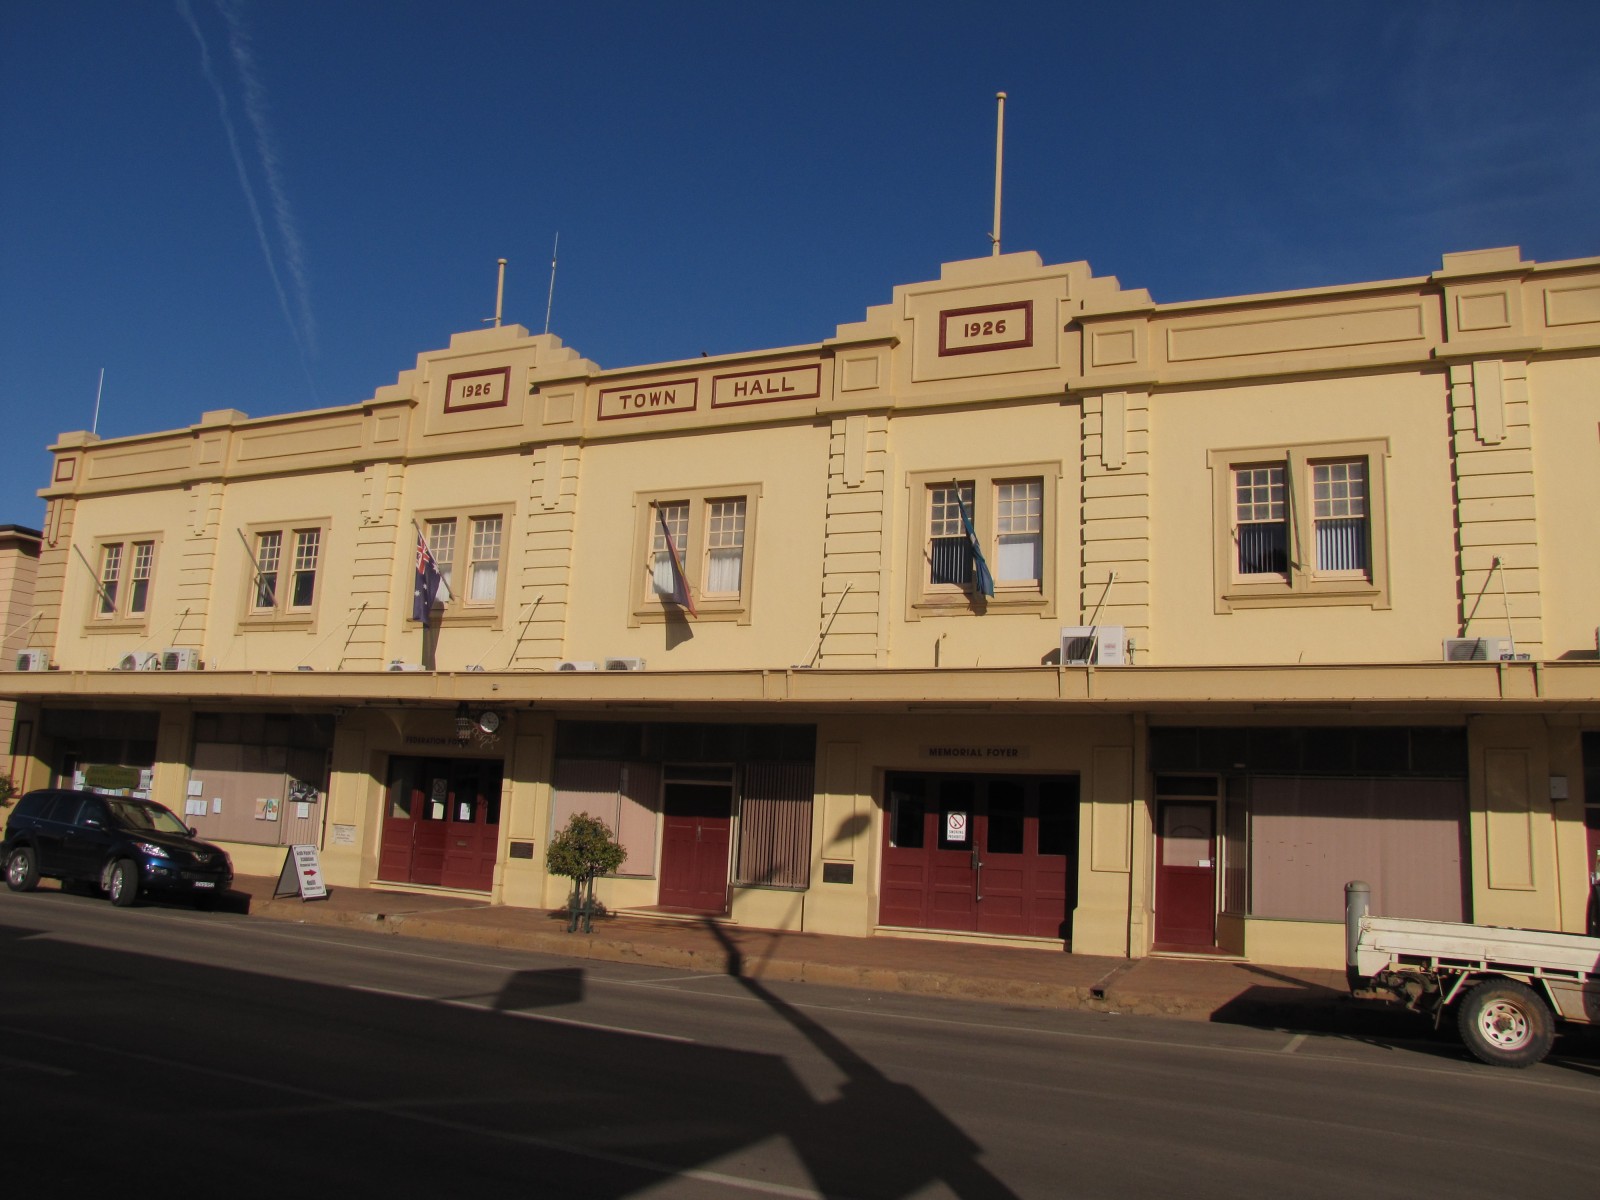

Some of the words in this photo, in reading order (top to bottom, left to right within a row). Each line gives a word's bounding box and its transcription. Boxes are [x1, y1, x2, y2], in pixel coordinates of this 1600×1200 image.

[964, 319, 1006, 338] 1926
[462, 382, 491, 398] 1926
[619, 389, 676, 410] TOWN
[733, 376, 795, 397] HALL
[929, 748, 983, 757] MEMORIAL
[987, 748, 1019, 757] FOYER
